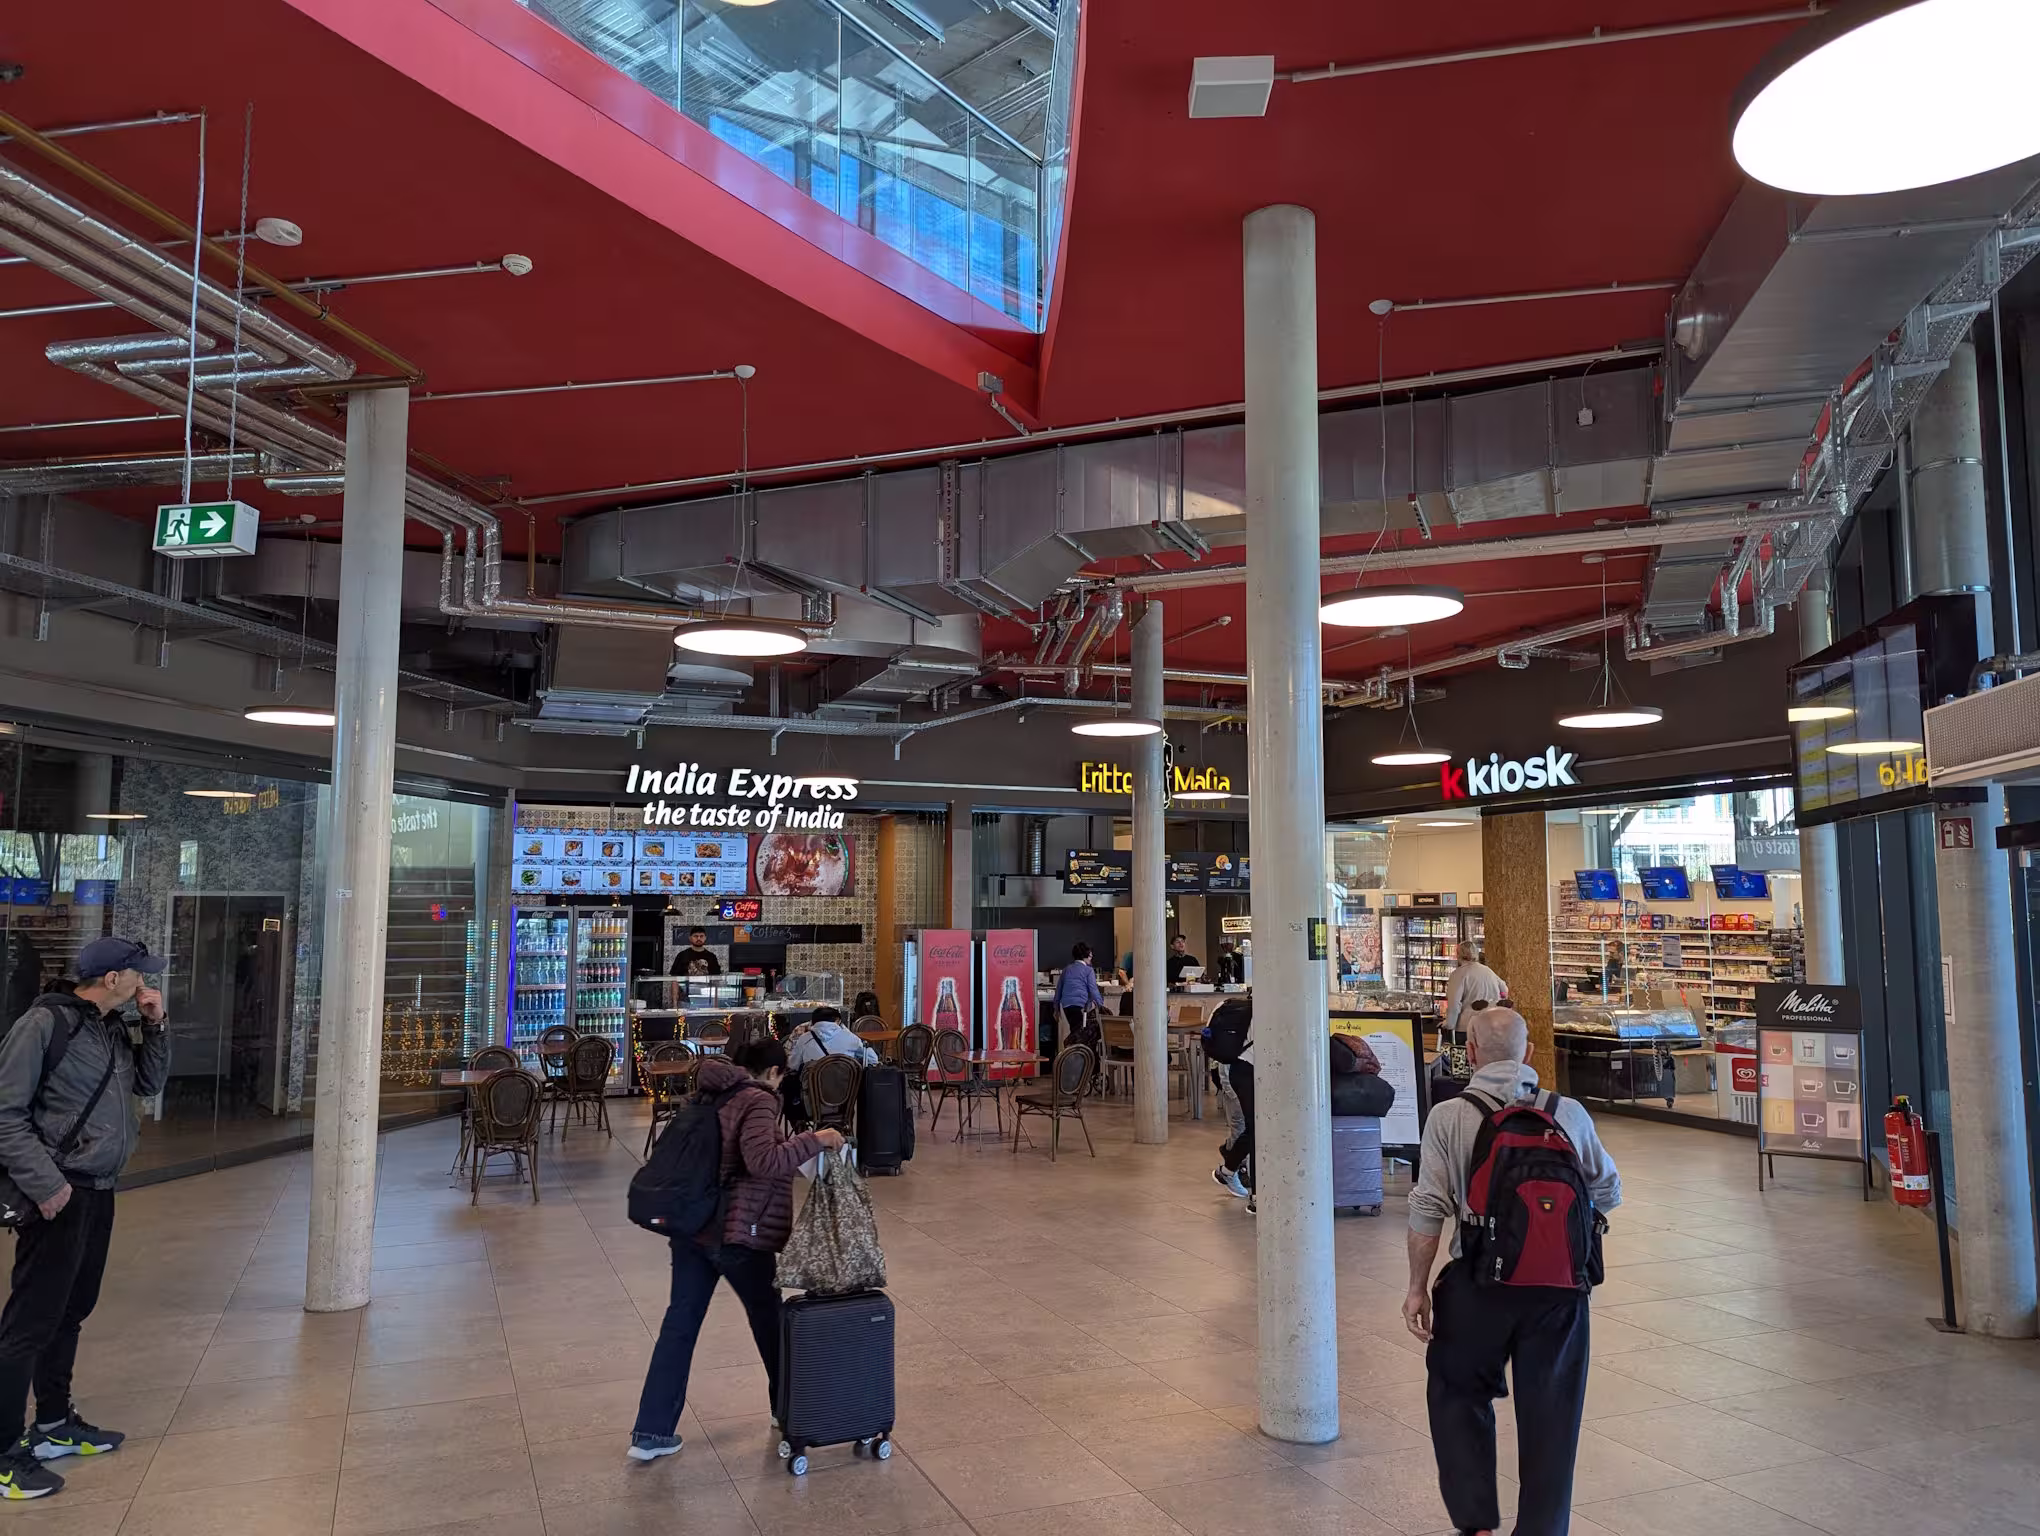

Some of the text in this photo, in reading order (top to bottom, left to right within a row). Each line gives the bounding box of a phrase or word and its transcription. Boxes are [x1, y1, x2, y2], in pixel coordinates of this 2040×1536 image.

[626, 762, 858, 807] India Express
[1082, 762, 1230, 793] Fritte Mafia
[1441, 745, 1576, 801] k kiosk
[643, 800, 844, 833] the taste of India
[735, 902, 758, 911] Coffee
[746, 912, 757, 920] go
[1781, 1014, 1832, 1023] PROFESSIONAL
